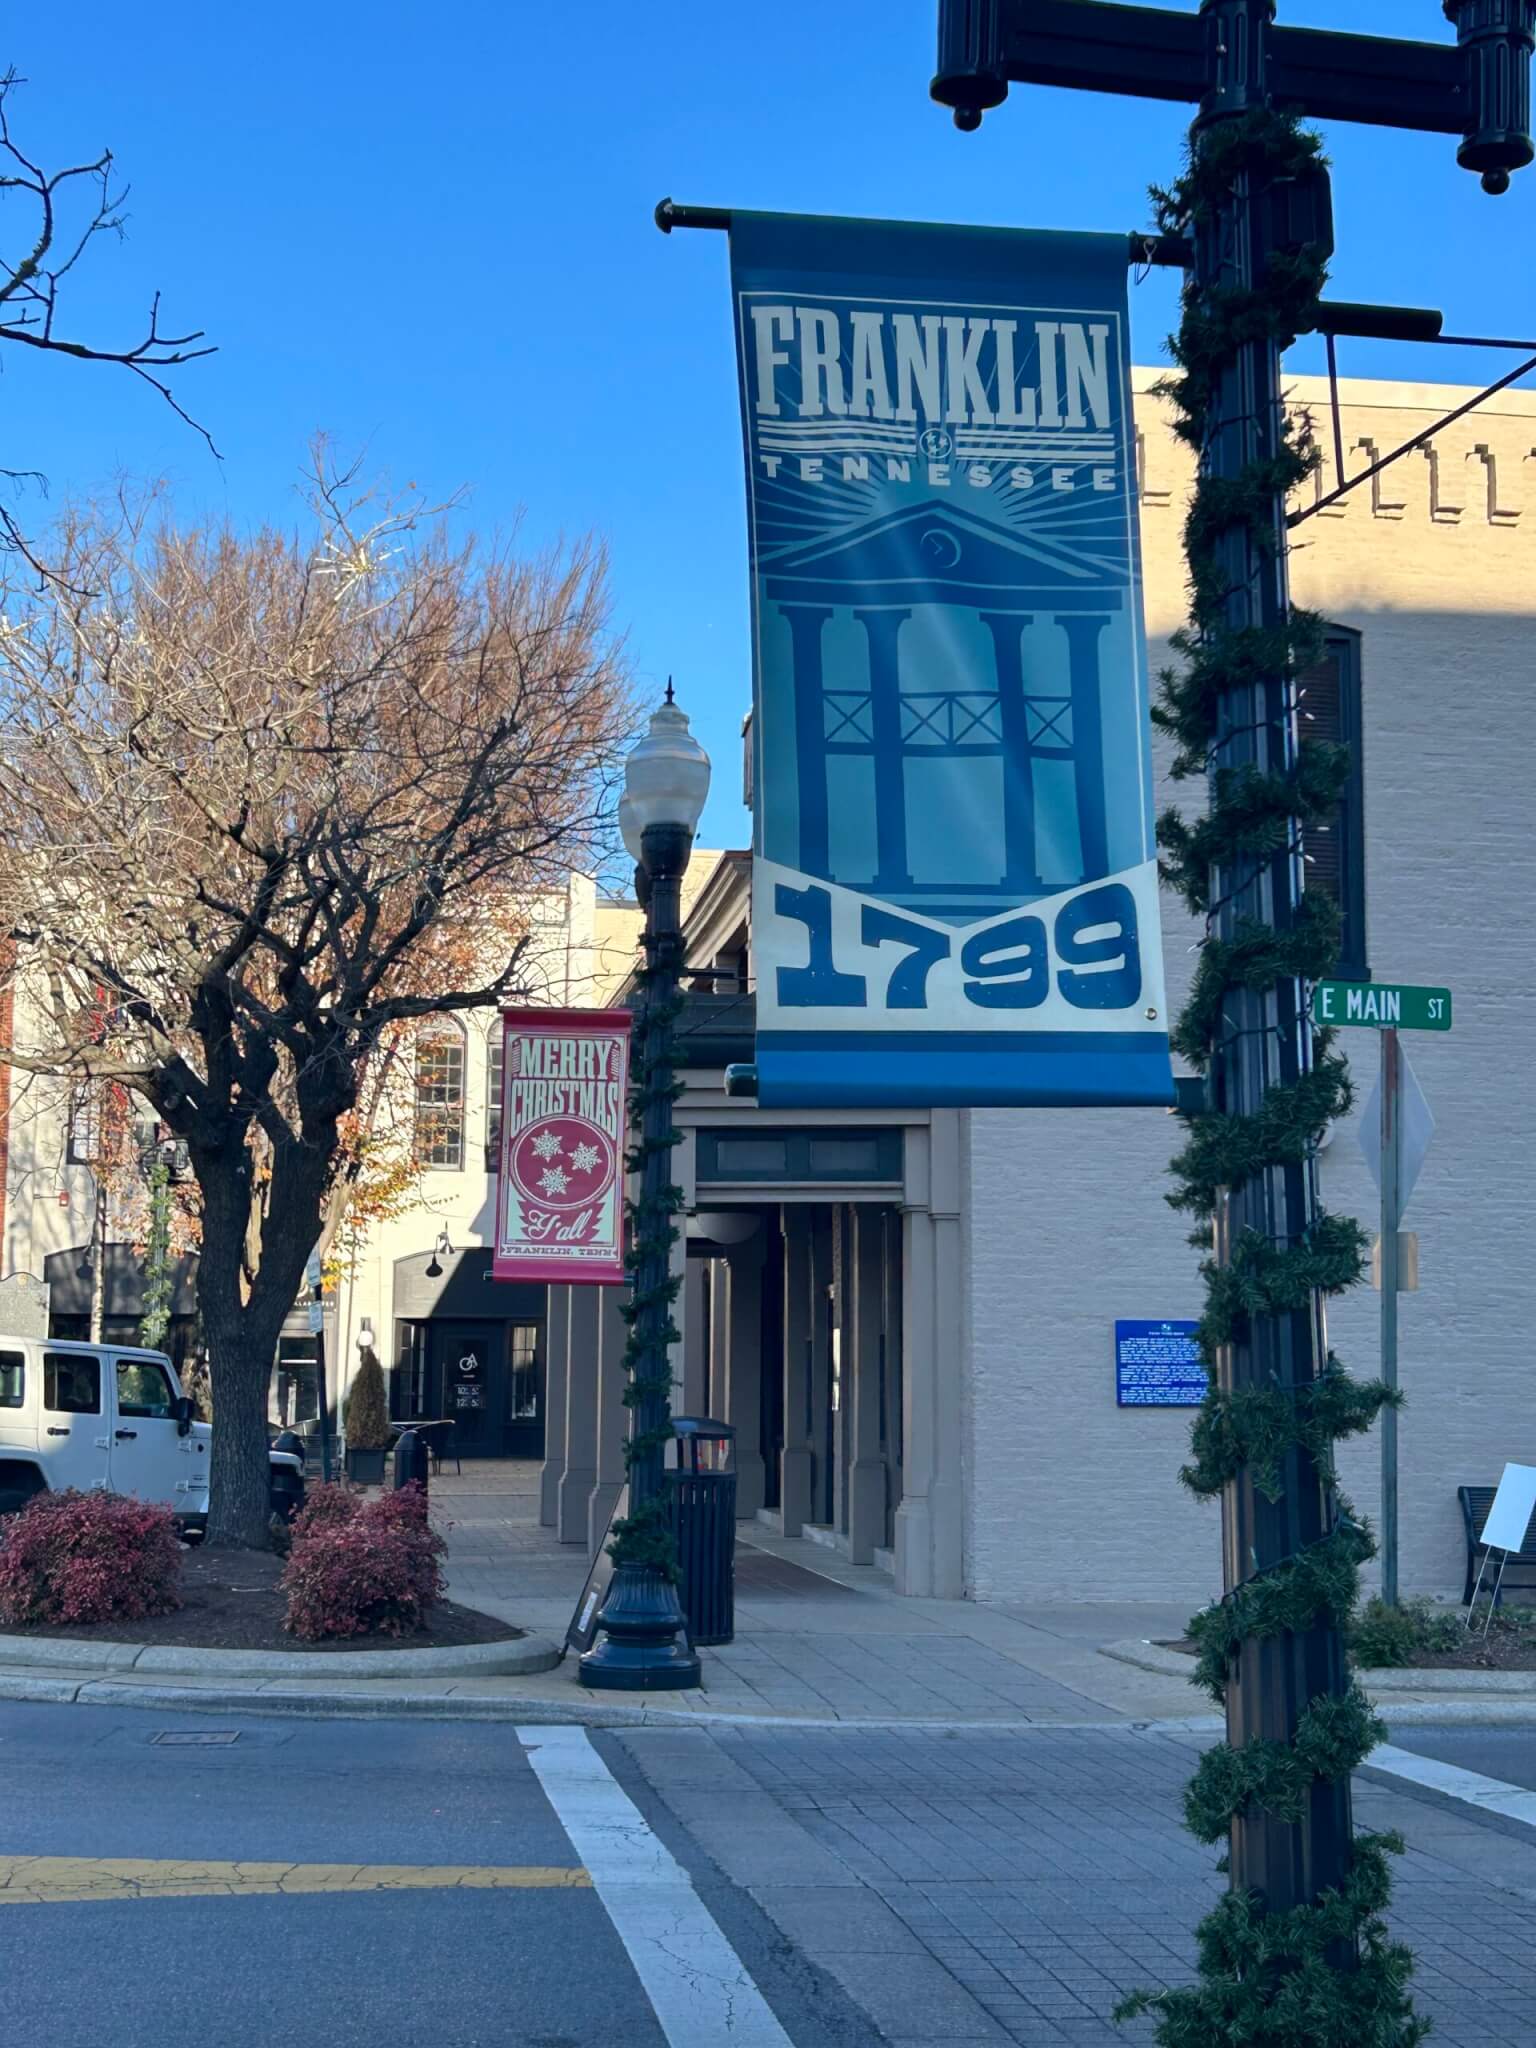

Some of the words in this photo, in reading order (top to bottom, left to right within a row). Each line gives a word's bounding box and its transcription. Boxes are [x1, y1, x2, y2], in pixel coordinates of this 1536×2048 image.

[751, 305, 1111, 429] FRANKLIN
[760, 455, 1116, 491] TENNESSEE
[774, 882, 1142, 1010] 1799
[1322, 987, 1335, 1018] E
[1347, 989, 1401, 1021] MAIN
[1427, 998, 1444, 1019] ST
[519, 1038, 613, 1080] MERRY
[511, 1079, 618, 1140] CHRISTMAS
[527, 1208, 594, 1242] Y'all
